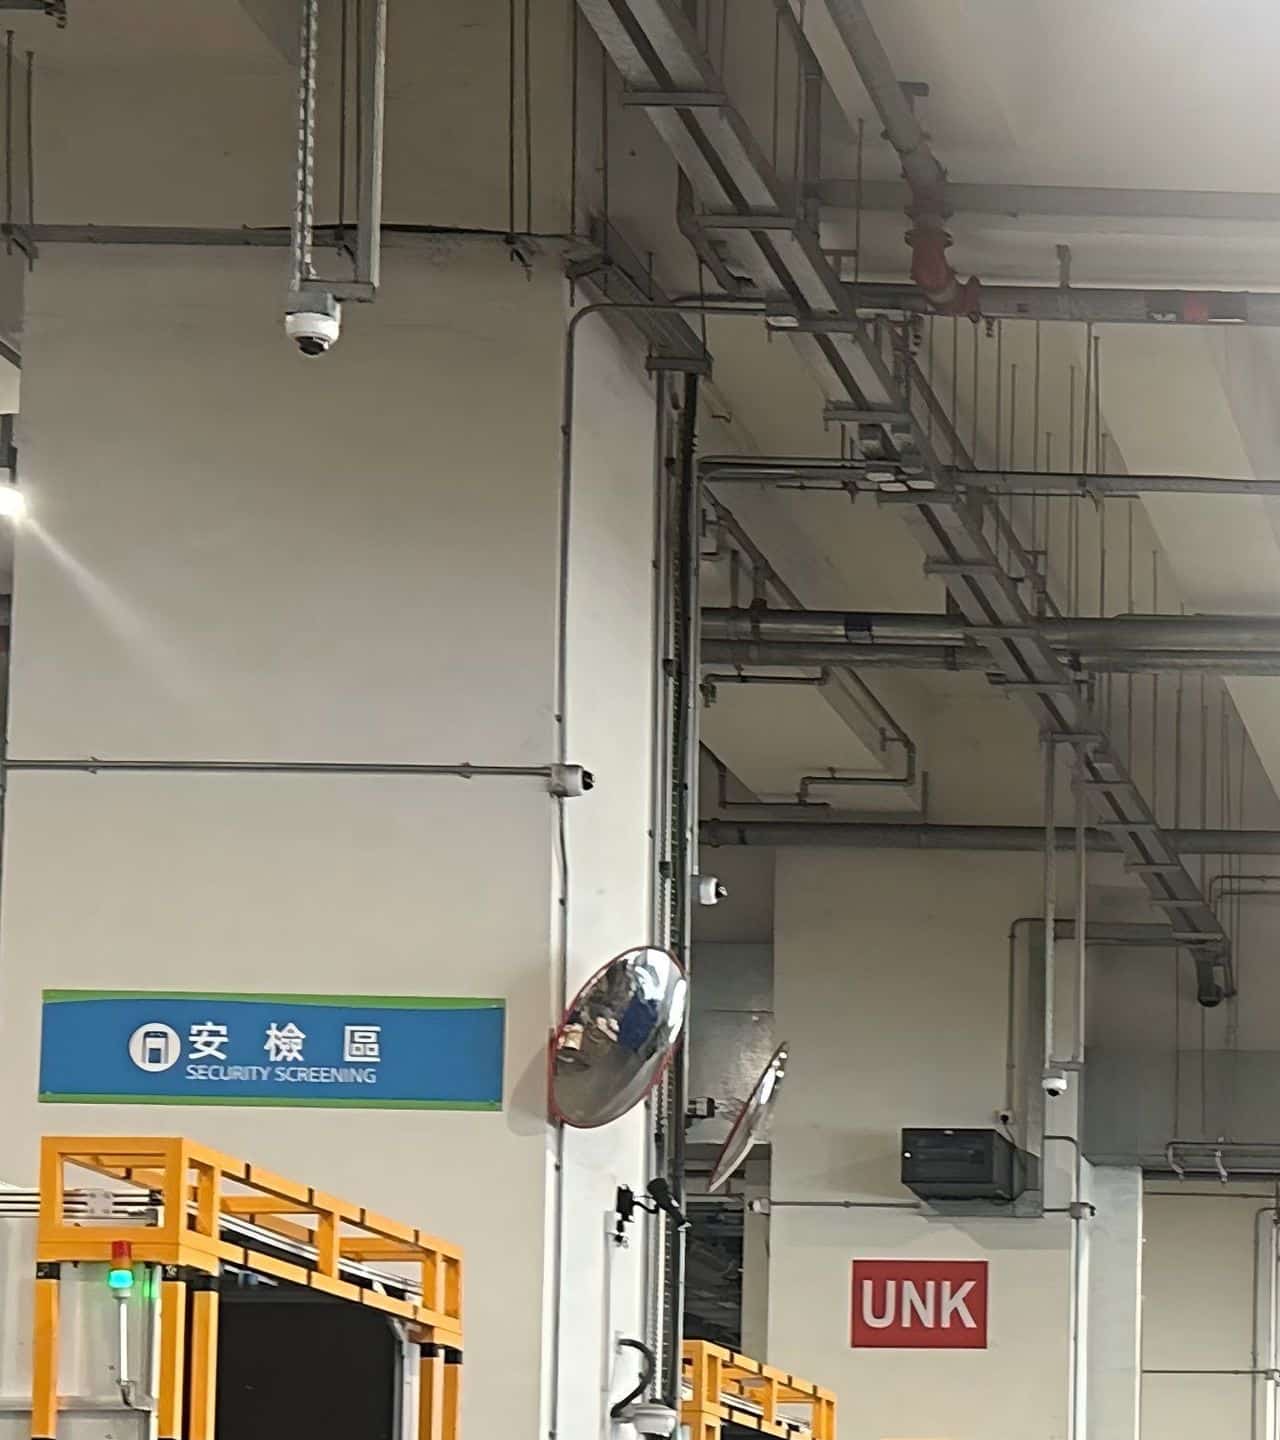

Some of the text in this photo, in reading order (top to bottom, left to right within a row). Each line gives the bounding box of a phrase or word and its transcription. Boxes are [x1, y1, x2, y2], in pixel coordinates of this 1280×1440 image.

[188, 1021, 381, 1062] 安檢區
[185, 1065, 377, 1083] SECURITY SCREENING
[862, 1279, 978, 1329] UNK
